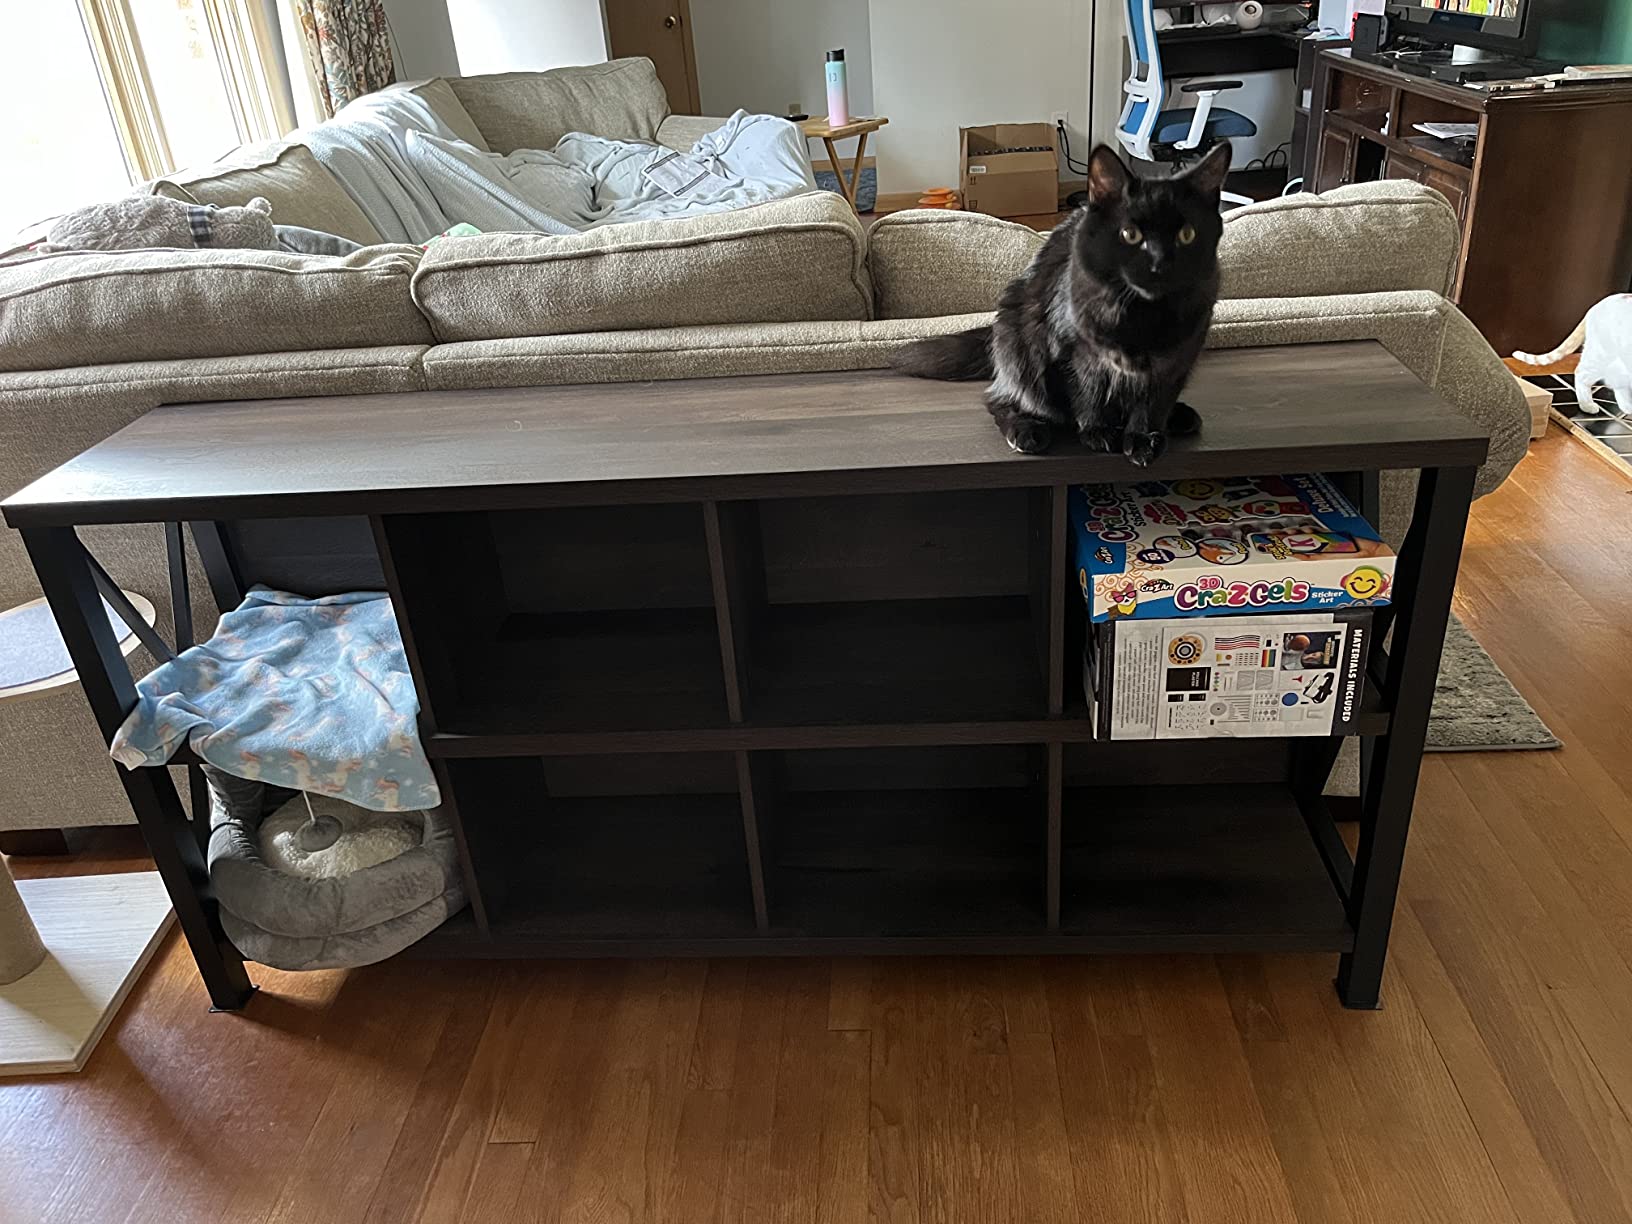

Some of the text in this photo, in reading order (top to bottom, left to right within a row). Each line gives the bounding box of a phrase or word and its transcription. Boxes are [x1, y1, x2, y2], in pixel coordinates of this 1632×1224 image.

[1128, 503, 1147, 527] Sticker
[1199, 577, 1221, 590] 3D
[1311, 591, 1344, 599] Sticker
[1341, 628, 1363, 722] MATERIALS INCLUDED
